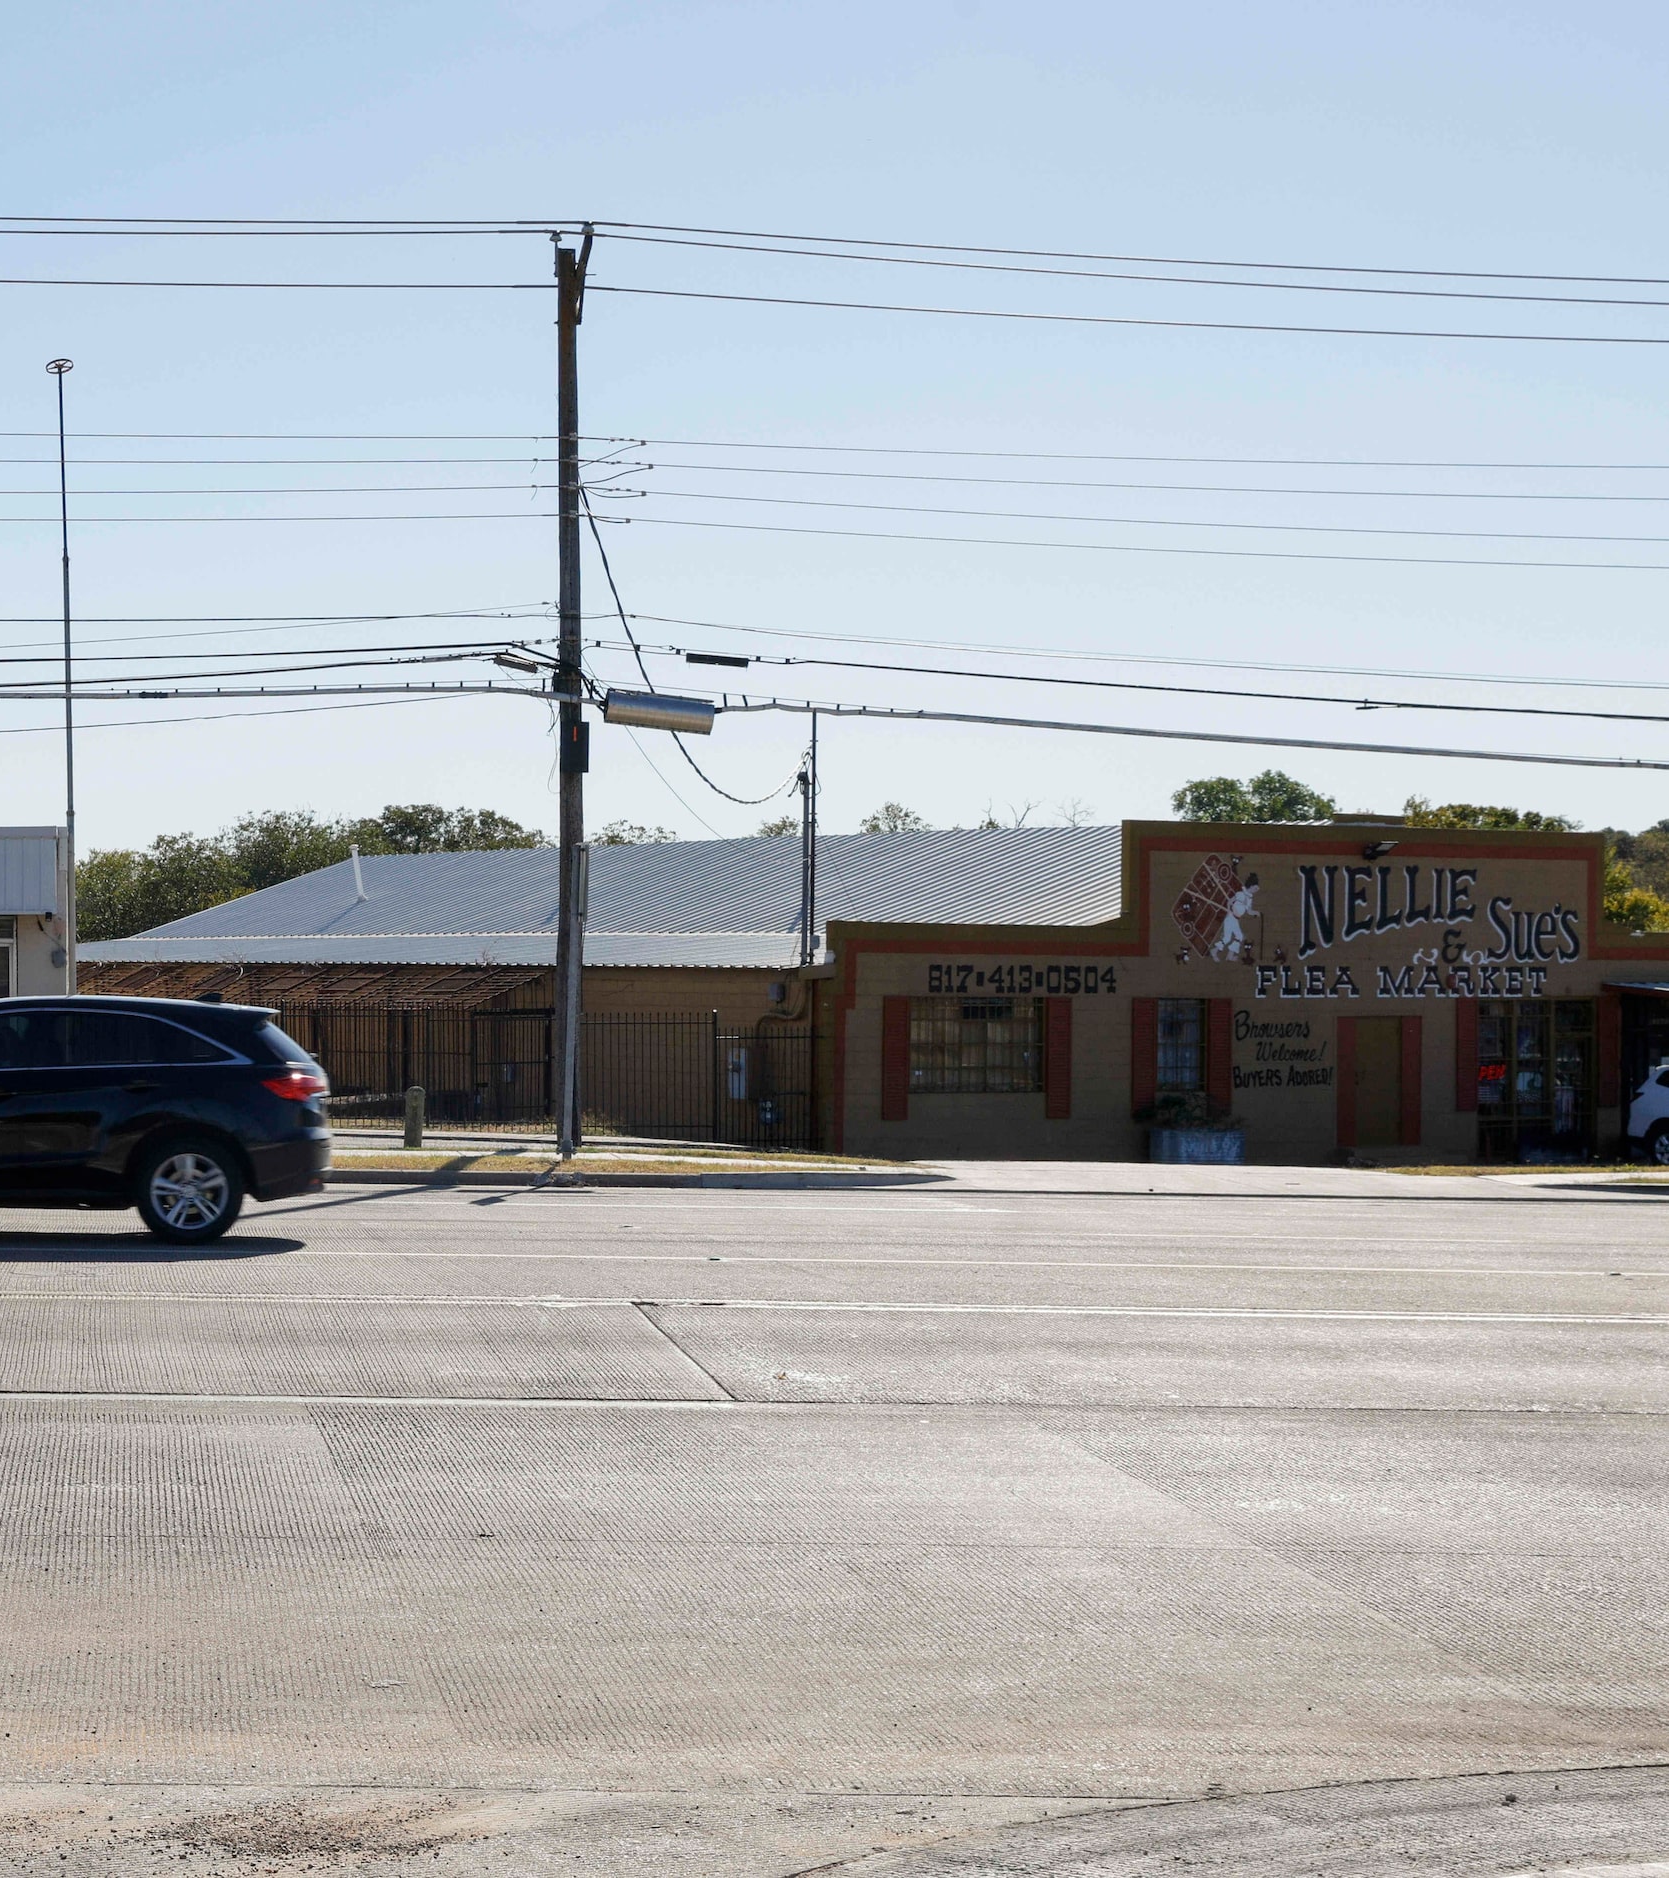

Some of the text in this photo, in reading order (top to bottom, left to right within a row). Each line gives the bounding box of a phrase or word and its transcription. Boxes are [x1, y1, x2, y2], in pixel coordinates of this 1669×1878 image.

[1297, 865, 1580, 964] NELLIE & Sue's
[1255, 966, 1547, 998] FLEA MARKET
[1234, 1010, 1310, 1041] Browsers
[1256, 1041, 1327, 1062] Welcome!
[1478, 1064, 1507, 1081] PEN
